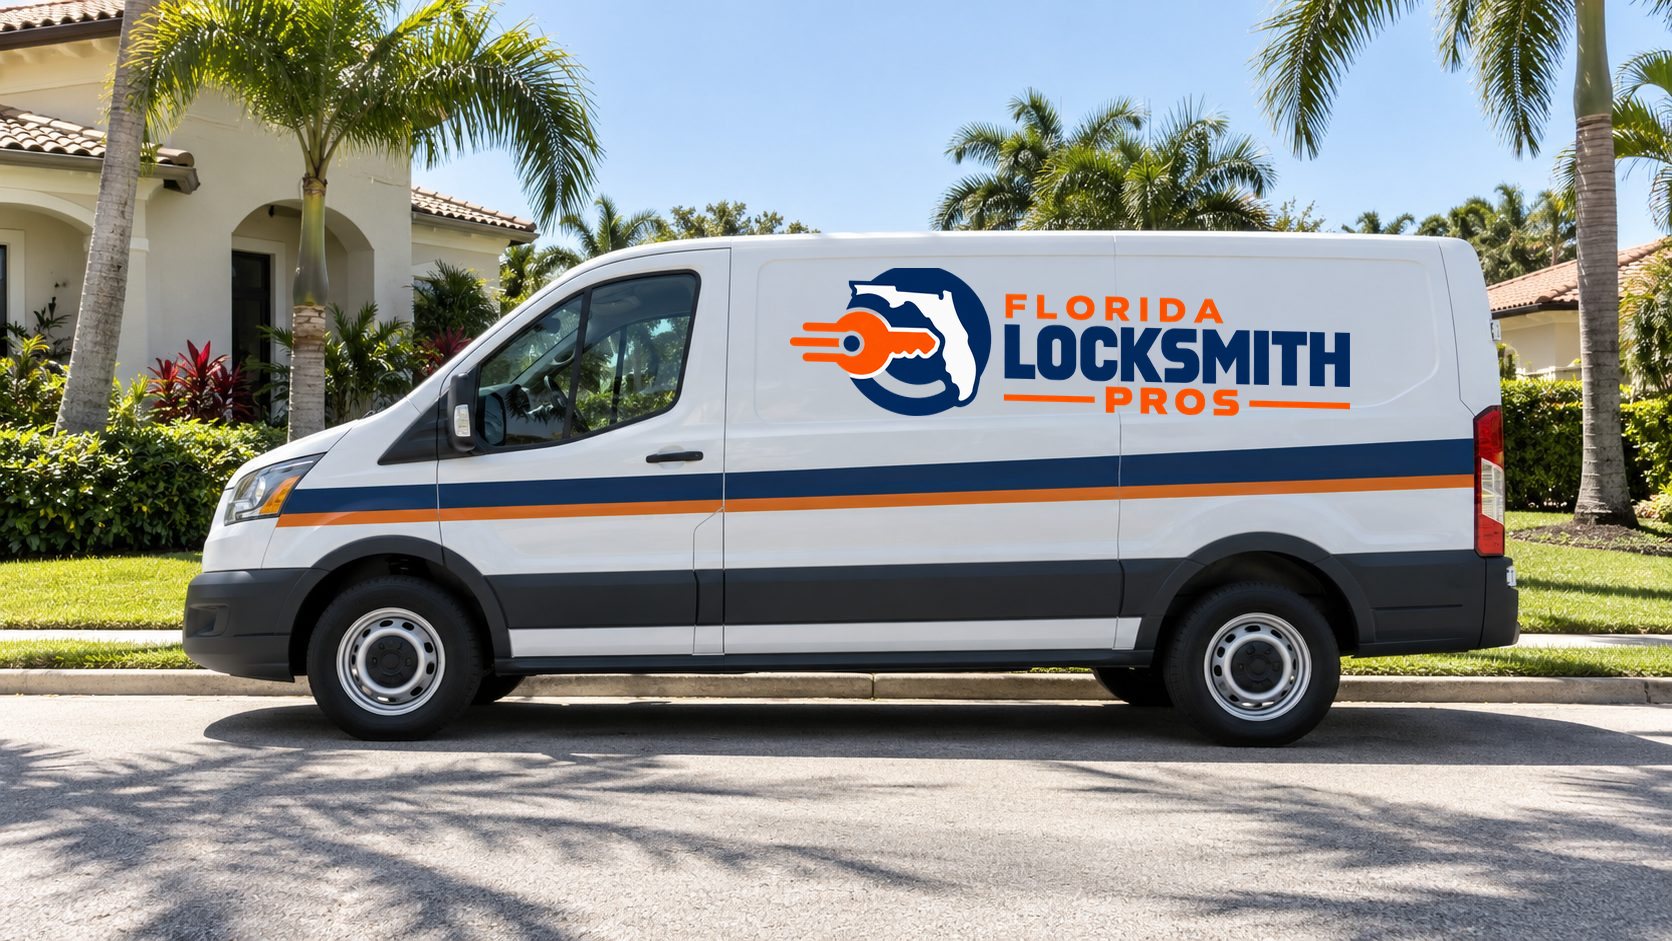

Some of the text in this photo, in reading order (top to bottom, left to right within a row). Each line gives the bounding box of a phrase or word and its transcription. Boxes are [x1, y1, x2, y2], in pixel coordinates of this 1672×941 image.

[1005, 294, 1223, 323] FLORIDA
[1004, 325, 1350, 387] LOCKSMITH
[1106, 387, 1239, 416] PROS
